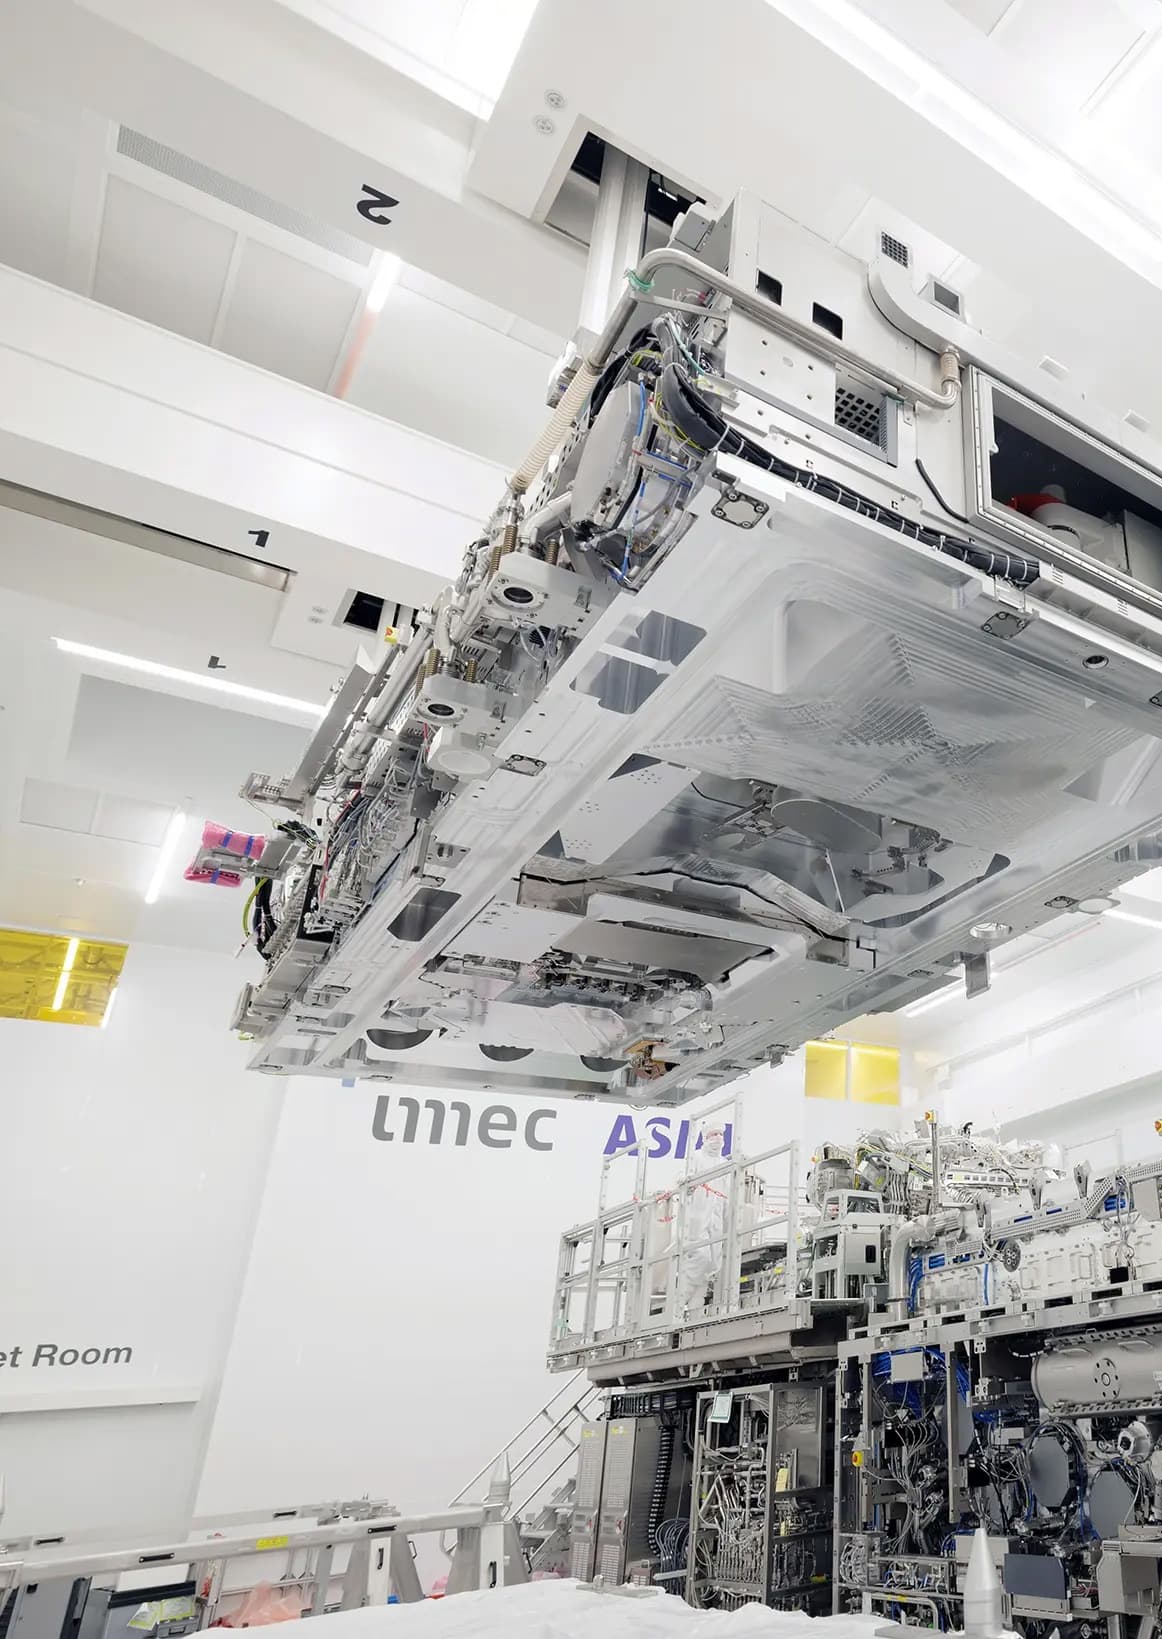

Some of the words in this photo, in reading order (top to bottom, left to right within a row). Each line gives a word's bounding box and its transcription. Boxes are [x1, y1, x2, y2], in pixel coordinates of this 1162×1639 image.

[357, 184, 400, 225] 2
[248, 530, 270, 548] 1
[208, 655, 226, 669] 1
[372, 1095, 557, 1151] imec
[32, 1344, 132, 1367] Room
